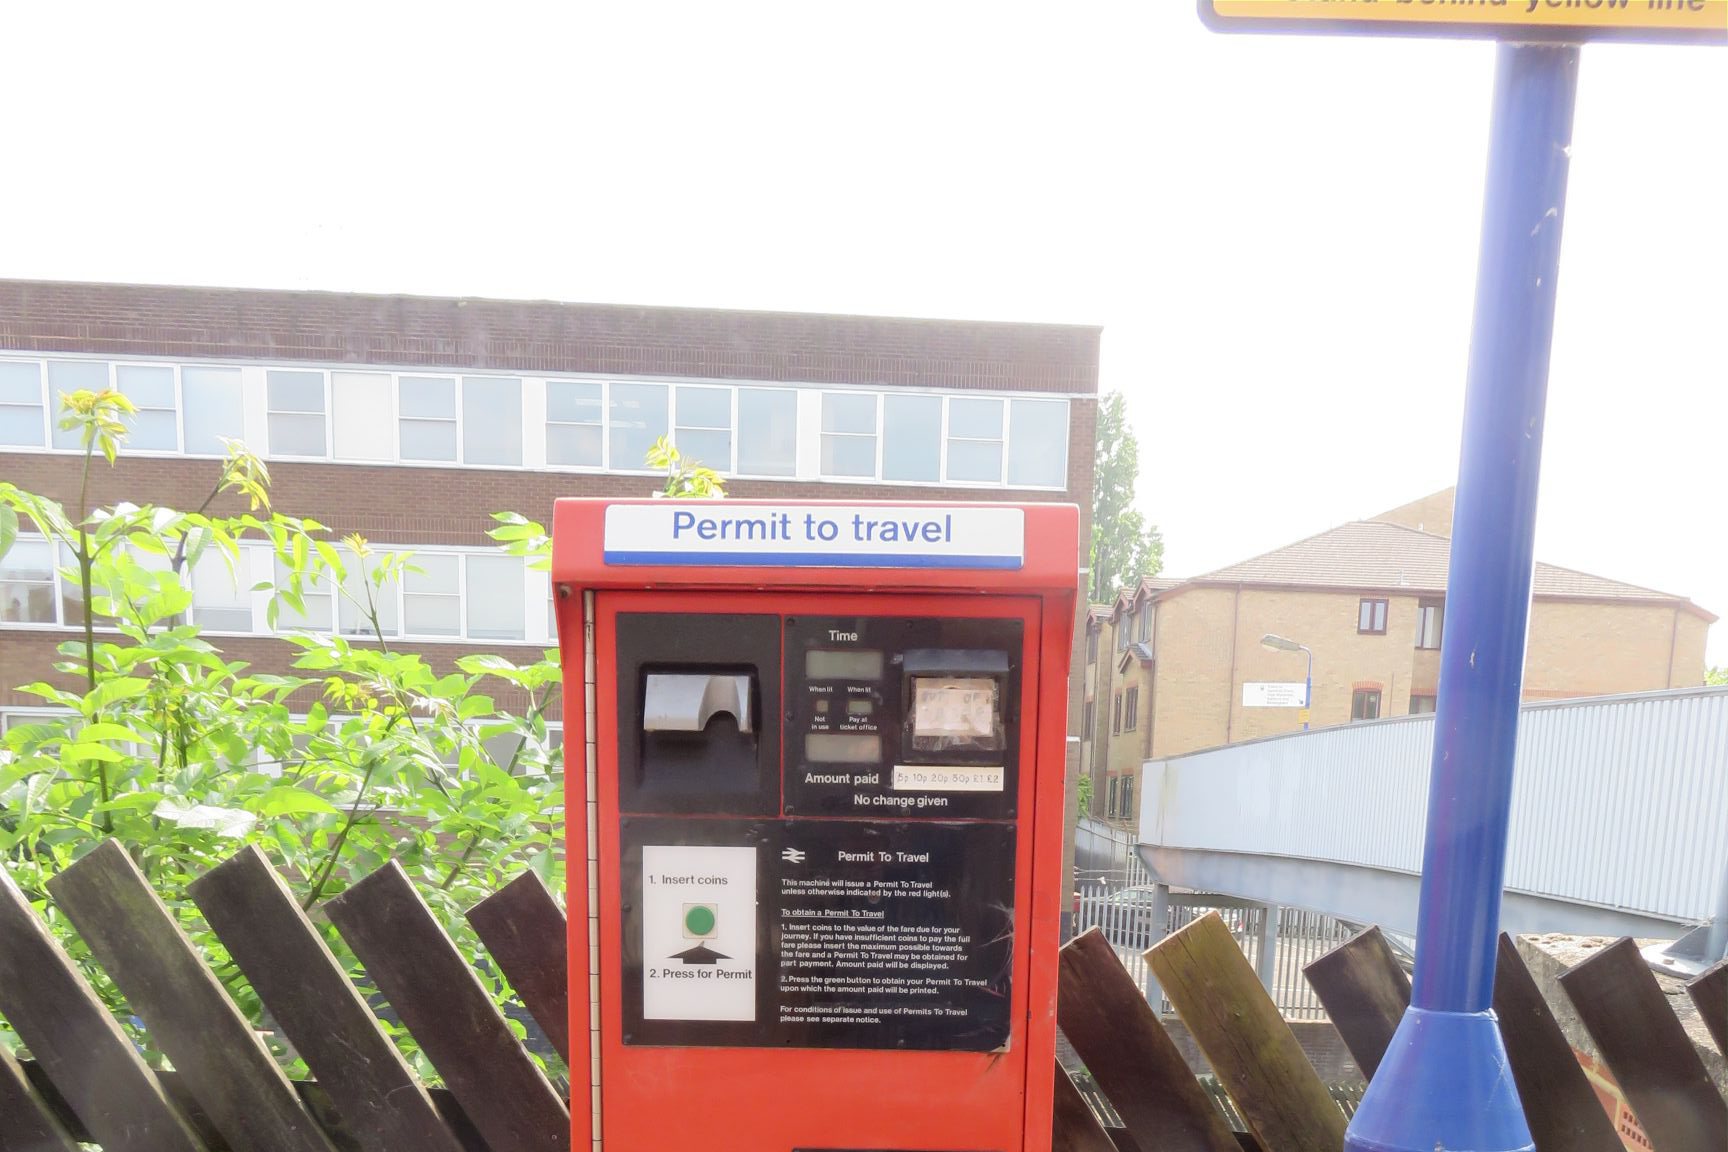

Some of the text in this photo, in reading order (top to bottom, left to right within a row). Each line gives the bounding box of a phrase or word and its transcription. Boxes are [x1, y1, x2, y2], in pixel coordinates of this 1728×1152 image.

[673, 512, 952, 543] Permit to travel
[829, 630, 858, 641] Time
[805, 773, 879, 786] Amount paid
[913, 773, 927, 784] 10p
[931, 774, 947, 784] 20p
[987, 775, 999, 783] £2
[854, 795, 947, 808] No change given
[838, 852, 929, 863] Permit To Travel
[648, 875, 728, 885] 1. Insert coins
[782, 879, 798, 887] This
[798, 879, 830, 887] machine
[844, 880, 864, 888] issue
[873, 880, 899, 888] Permit
[900, 880, 909, 888] To
[807, 888, 845, 896] otherwise
[846, 888, 881, 896] indicated
[882, 889, 892, 898] by
[894, 889, 907, 897] the
[908, 889, 921, 897] red
[923, 889, 951, 899] light(s).
[781, 909, 790, 917] To
[792, 909, 816, 917] obtain
[824, 909, 849, 917] Permit
[781, 923, 787, 931] 1.
[789, 923, 810, 931] Insert
[812, 924, 832, 932] coins
[833, 924, 842, 932] to
[843, 924, 855, 932] the
[856, 924, 876, 932] value
[900, 925, 915, 933] fare
[916, 925, 930, 933] due
[931, 925, 942, 933] for
[943, 927, 960, 935] your
[781, 934, 811, 942] journey.
[813, 933, 819, 941] If
[820, 935, 834, 943] you
[835, 933, 852, 941] have
[854, 934, 896, 942] insufficient
[898, 934, 918, 942] coins
[929, 936, 942, 944] pay
[944, 935, 956, 943] the
[958, 935, 970, 943] full
[781, 941, 796, 949] fare
[797, 942, 821, 951] please
[823, 942, 845, 950] insert
[847, 942, 860, 950] the
[899, 943, 930, 953] possible
[781, 950, 794, 958] the
[812, 951, 825, 959] and
[833, 951, 859, 959] Permit
[894, 954, 909, 962] may
[911, 952, 920, 960] be
[957, 953, 968, 961] for
[781, 960, 797, 969] part
[799, 960, 834, 969] payment.
[836, 960, 865, 968] Amount
[867, 961, 884, 970] paid
[898, 961, 908, 969] be
[910, 961, 949, 971] displayed.
[650, 969, 752, 979] 2. Press for Permit
[781, 975, 788, 983] 2.
[810, 976, 823, 984] the
[824, 978, 846, 986] green
[846, 976, 871, 984] button
[881, 977, 905, 985] obtain
[906, 979, 924, 987] your
[953, 978, 963, 986] To
[964, 978, 987, 986] Travel
[780, 986, 799, 994] upon
[824, 985, 836, 993] the
[867, 986, 884, 995] paid
[885, 986, 897, 994] will
[898, 986, 908, 994] be
[910, 986, 939, 996] printed.
[780, 1005, 792, 1013] For
[833, 1006, 841, 1014] of
[842, 1006, 862, 1014] issue
[864, 1006, 877, 1014] and
[894, 1007, 902, 1015] of
[903, 1007, 932, 1015] Permits
[934, 1007, 943, 1015] To
[780, 1015, 804, 1024] please
[822, 1016, 854, 1025] separate
